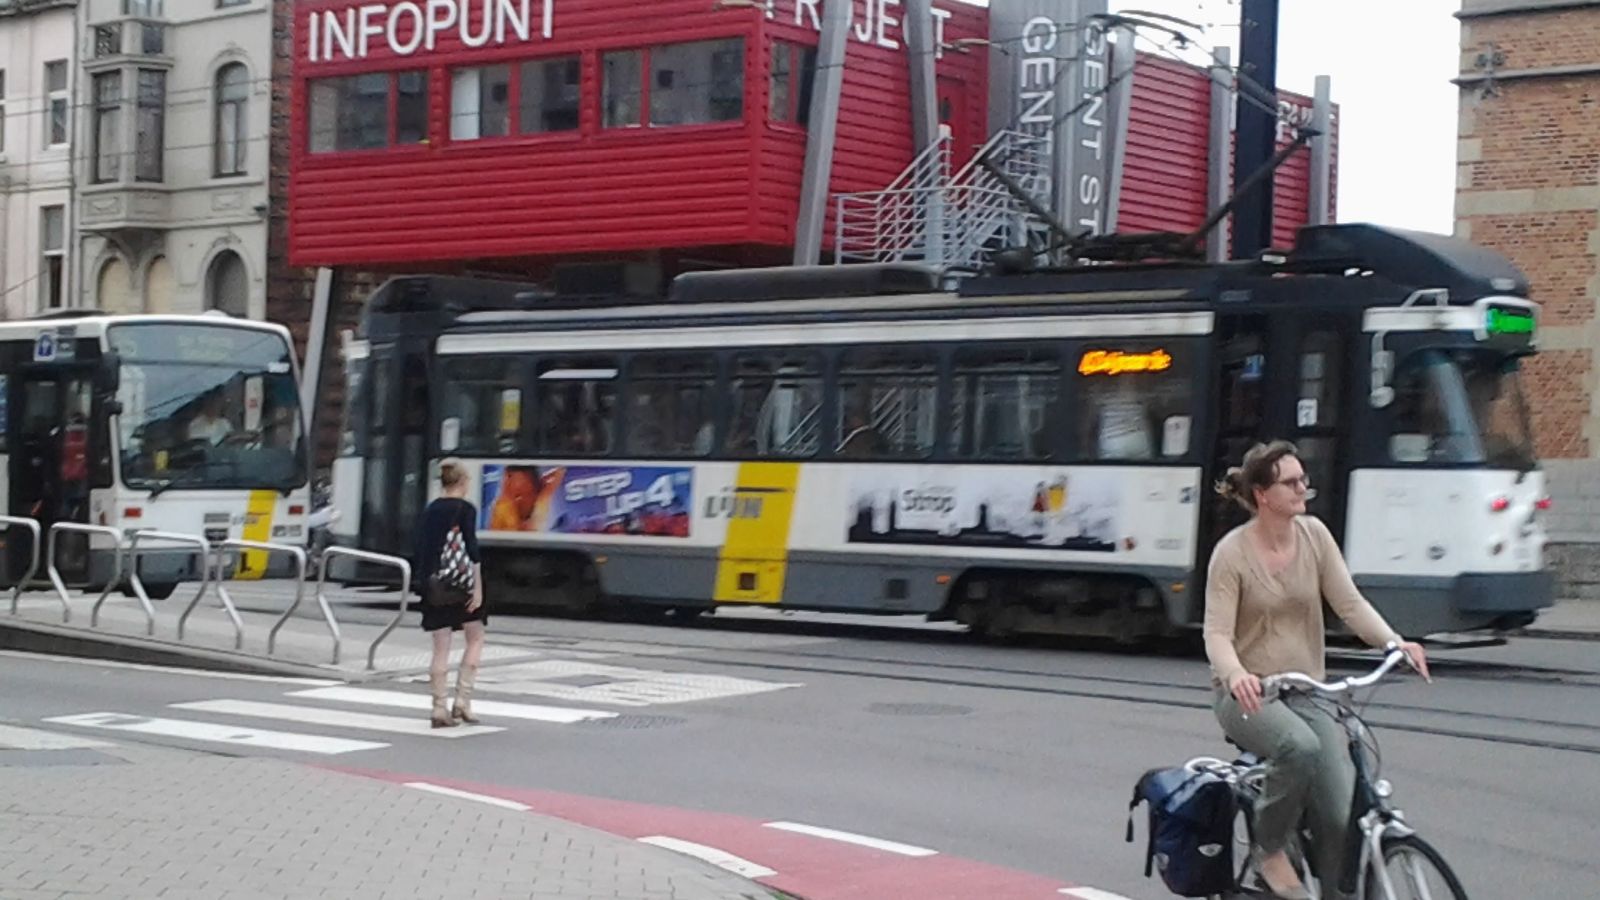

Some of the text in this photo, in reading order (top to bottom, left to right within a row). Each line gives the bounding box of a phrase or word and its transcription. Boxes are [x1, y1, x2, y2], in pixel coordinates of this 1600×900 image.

[308, 0, 557, 61] INFOPUNT
[1082, 21, 1105, 160] GENT
[565, 471, 632, 502] STEP
[606, 474, 675, 516] UP 4
